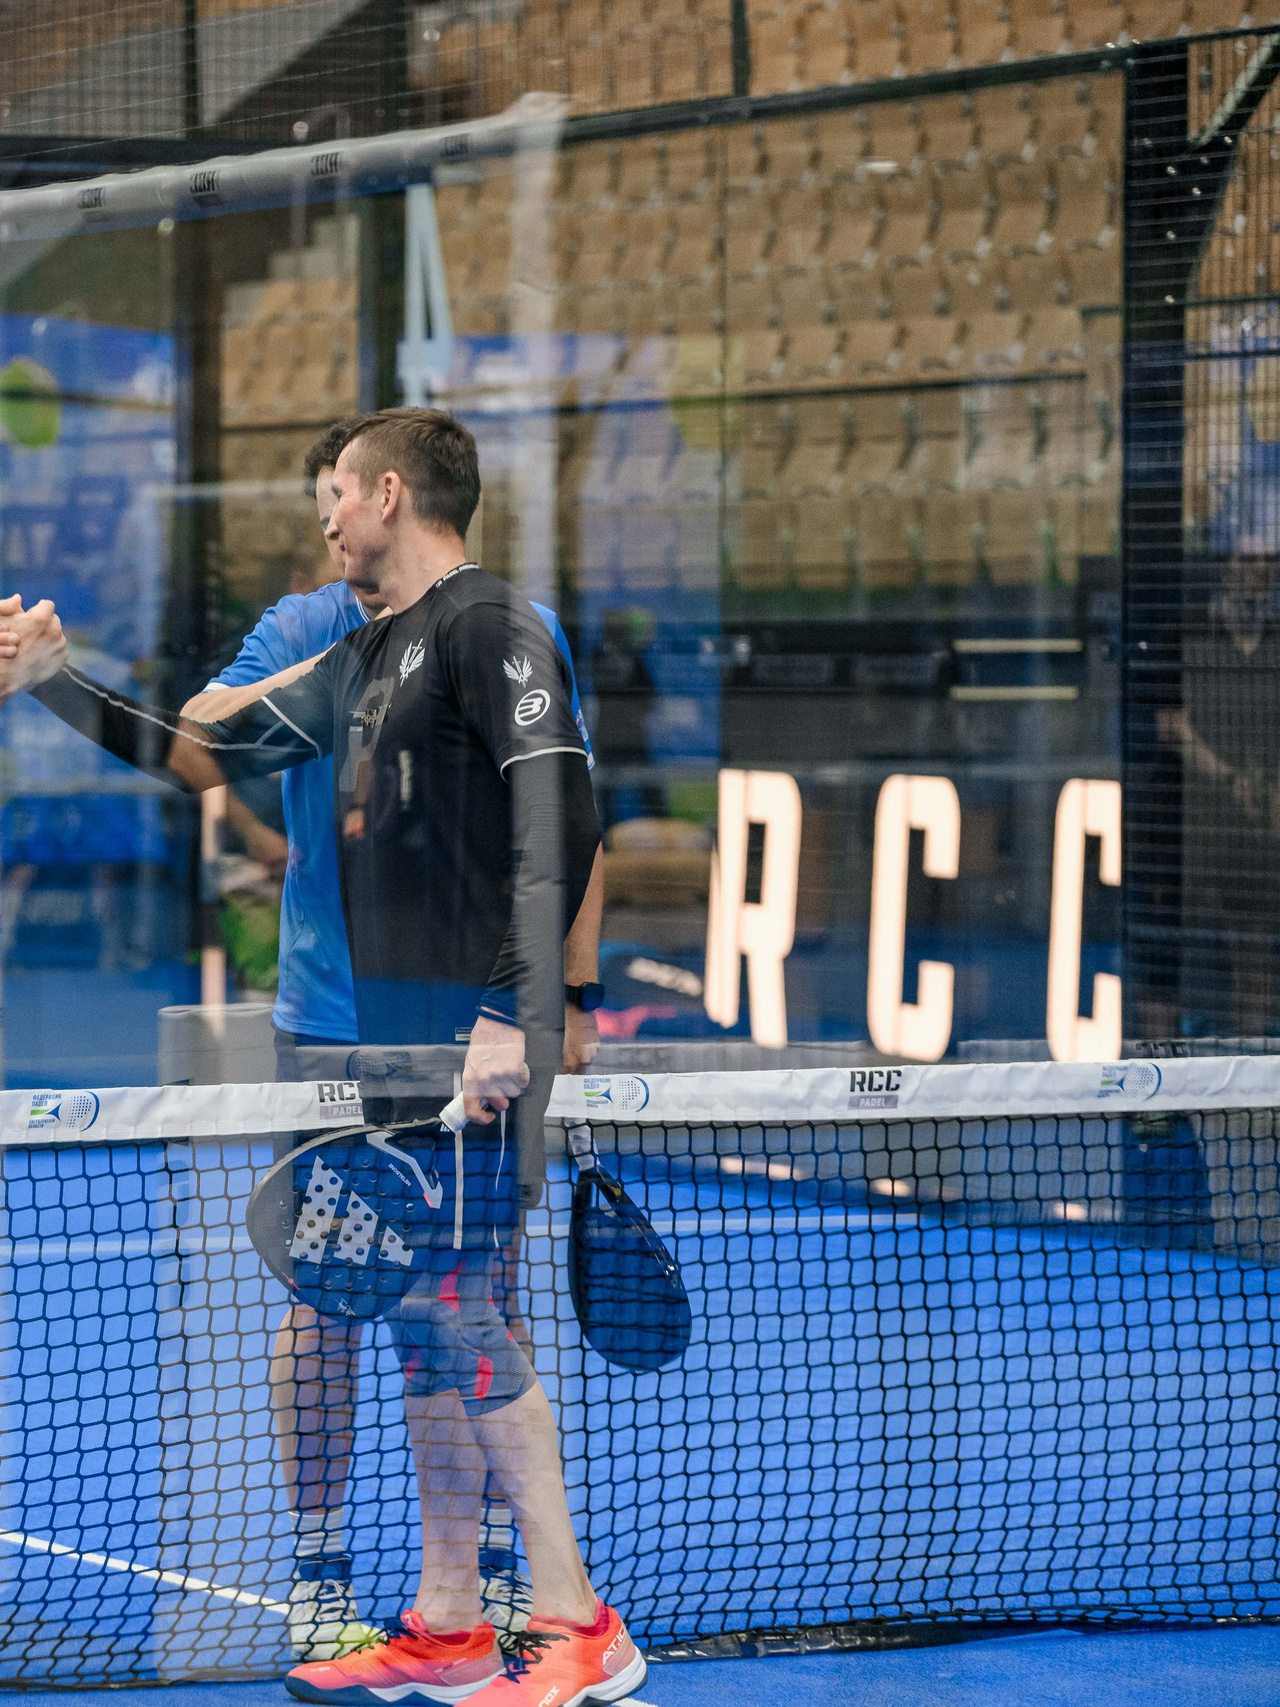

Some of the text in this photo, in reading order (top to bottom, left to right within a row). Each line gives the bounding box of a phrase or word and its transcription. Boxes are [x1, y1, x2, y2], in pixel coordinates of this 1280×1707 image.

[849, 1070, 902, 1092] RCC
[860, 1097, 887, 1107] PADEL
[332, 1104, 362, 1116] PADEL
